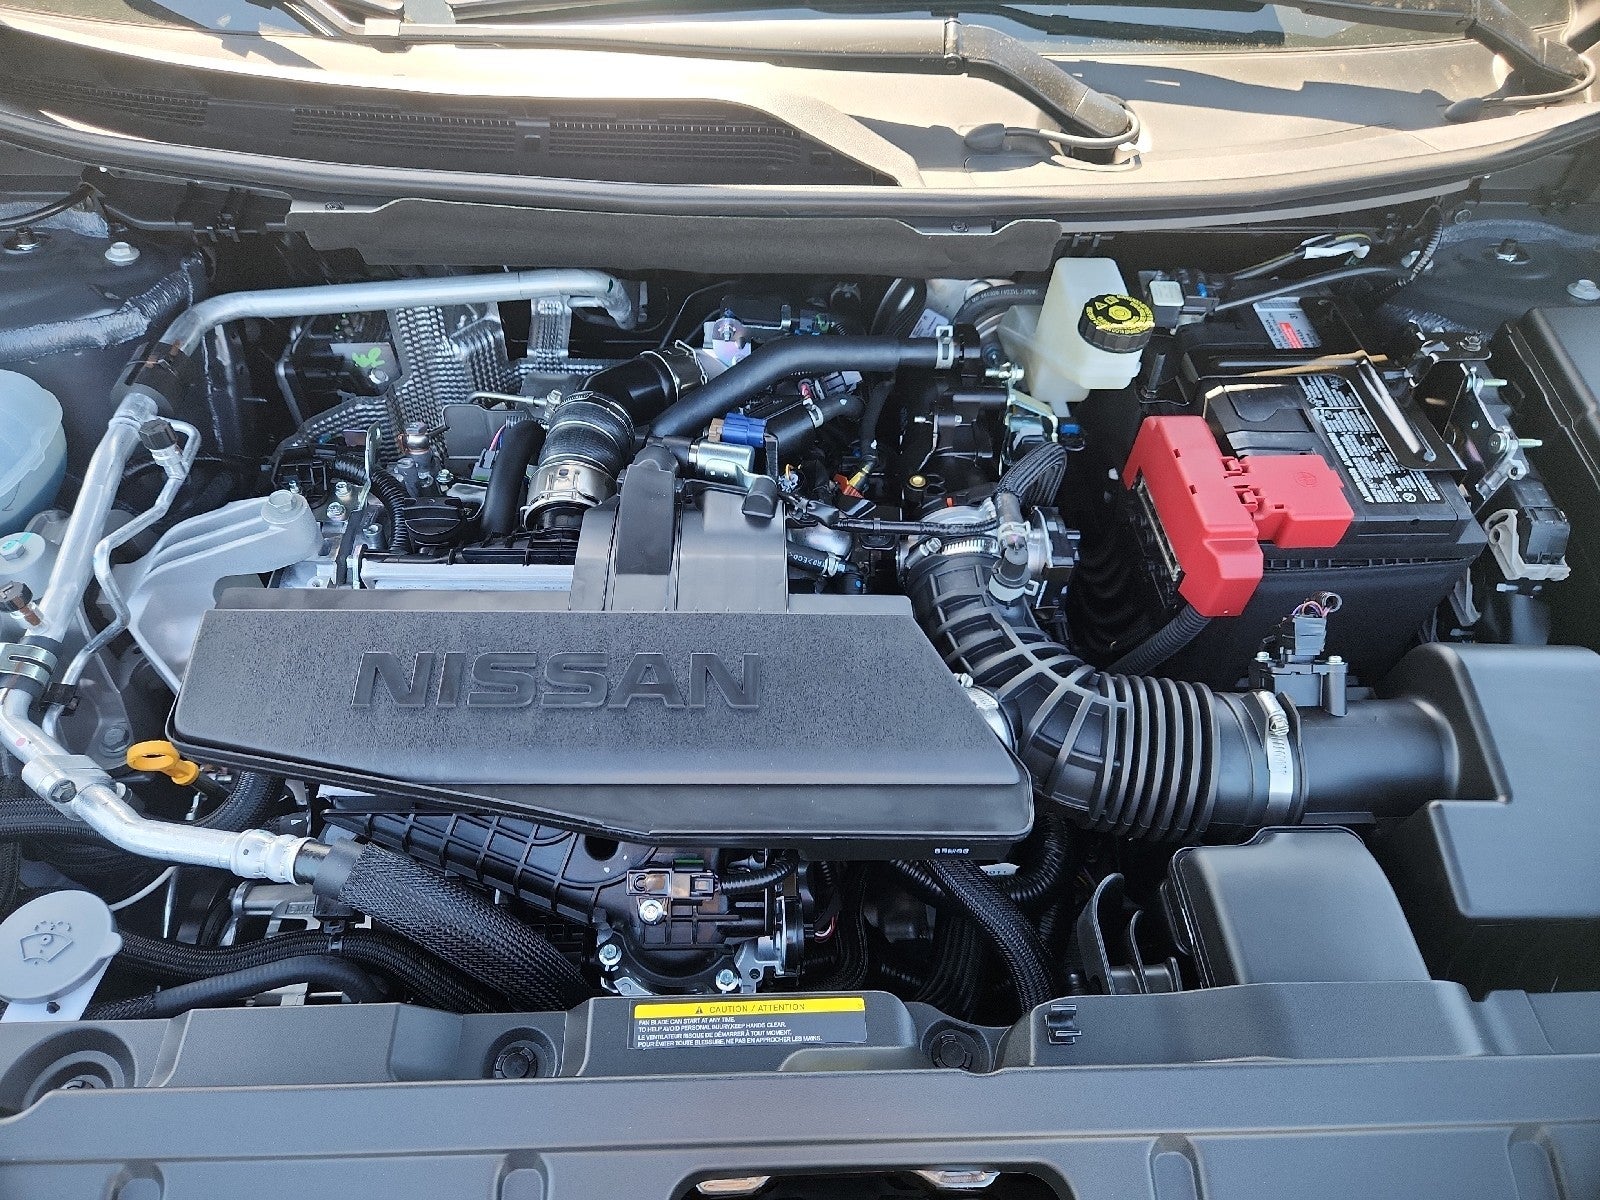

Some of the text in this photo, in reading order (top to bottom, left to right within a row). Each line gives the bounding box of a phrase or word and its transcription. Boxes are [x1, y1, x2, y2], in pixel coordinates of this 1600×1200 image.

[350, 651, 760, 709] NISSAN
[710, 1005, 748, 1014] CAUTION
[758, 1004, 805, 1012] ATTENTION
[714, 1030, 745, 1038] DÉMARRER
[655, 1039, 675, 1047] ÉVITER
